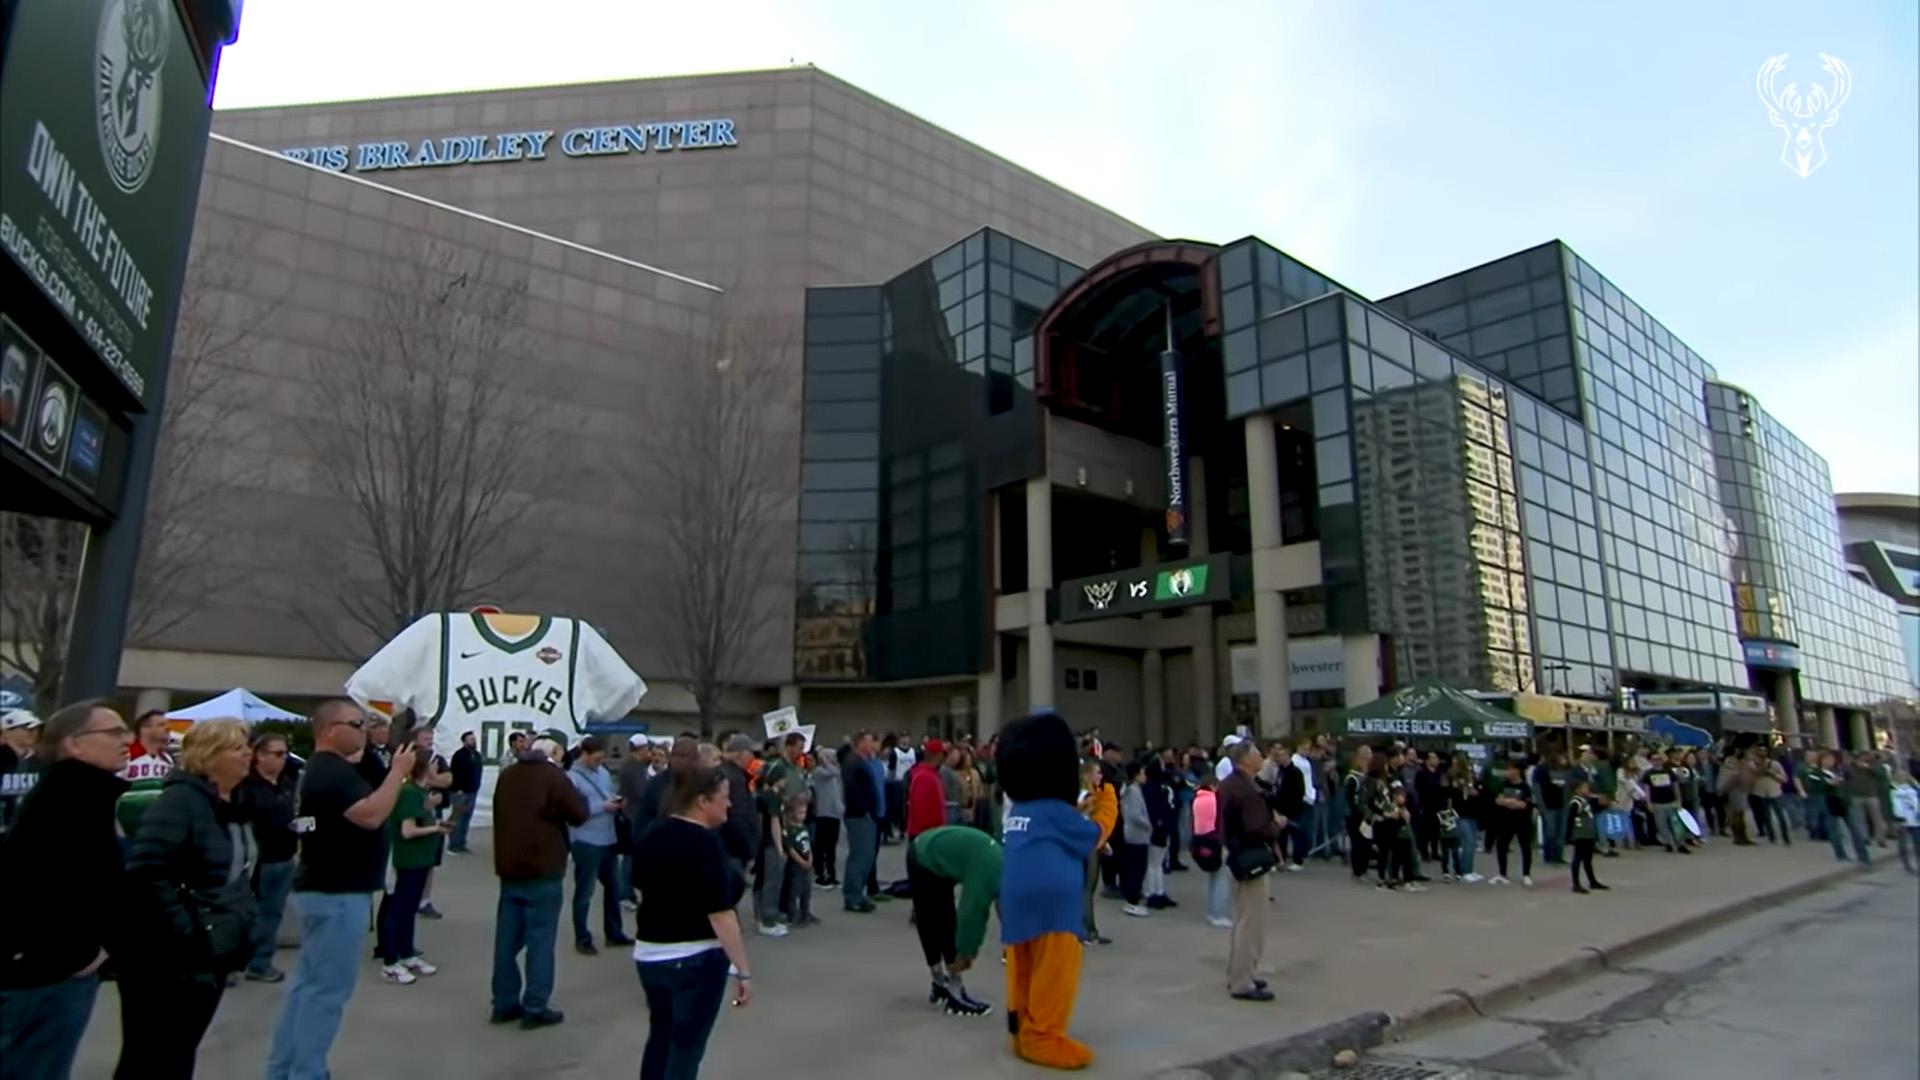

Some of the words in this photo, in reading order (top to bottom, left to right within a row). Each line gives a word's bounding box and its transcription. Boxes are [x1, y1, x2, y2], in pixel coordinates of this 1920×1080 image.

[355, 129, 554, 173] BRADLEY
[561, 118, 739, 156] CENTER
[28, 119, 75, 218] OWN
[73, 181, 107, 262] THE
[102, 228, 154, 330] FUTURE
[0, 213, 76, 318] BUCKS.COM
[1164, 370, 1178, 415] Mutual
[1167, 417, 1183, 506] Northwestern
[455, 675, 563, 715] BUCKS
[1347, 718, 1410, 734] MILWAUKEE
[1411, 719, 1451, 736] BUCKS
